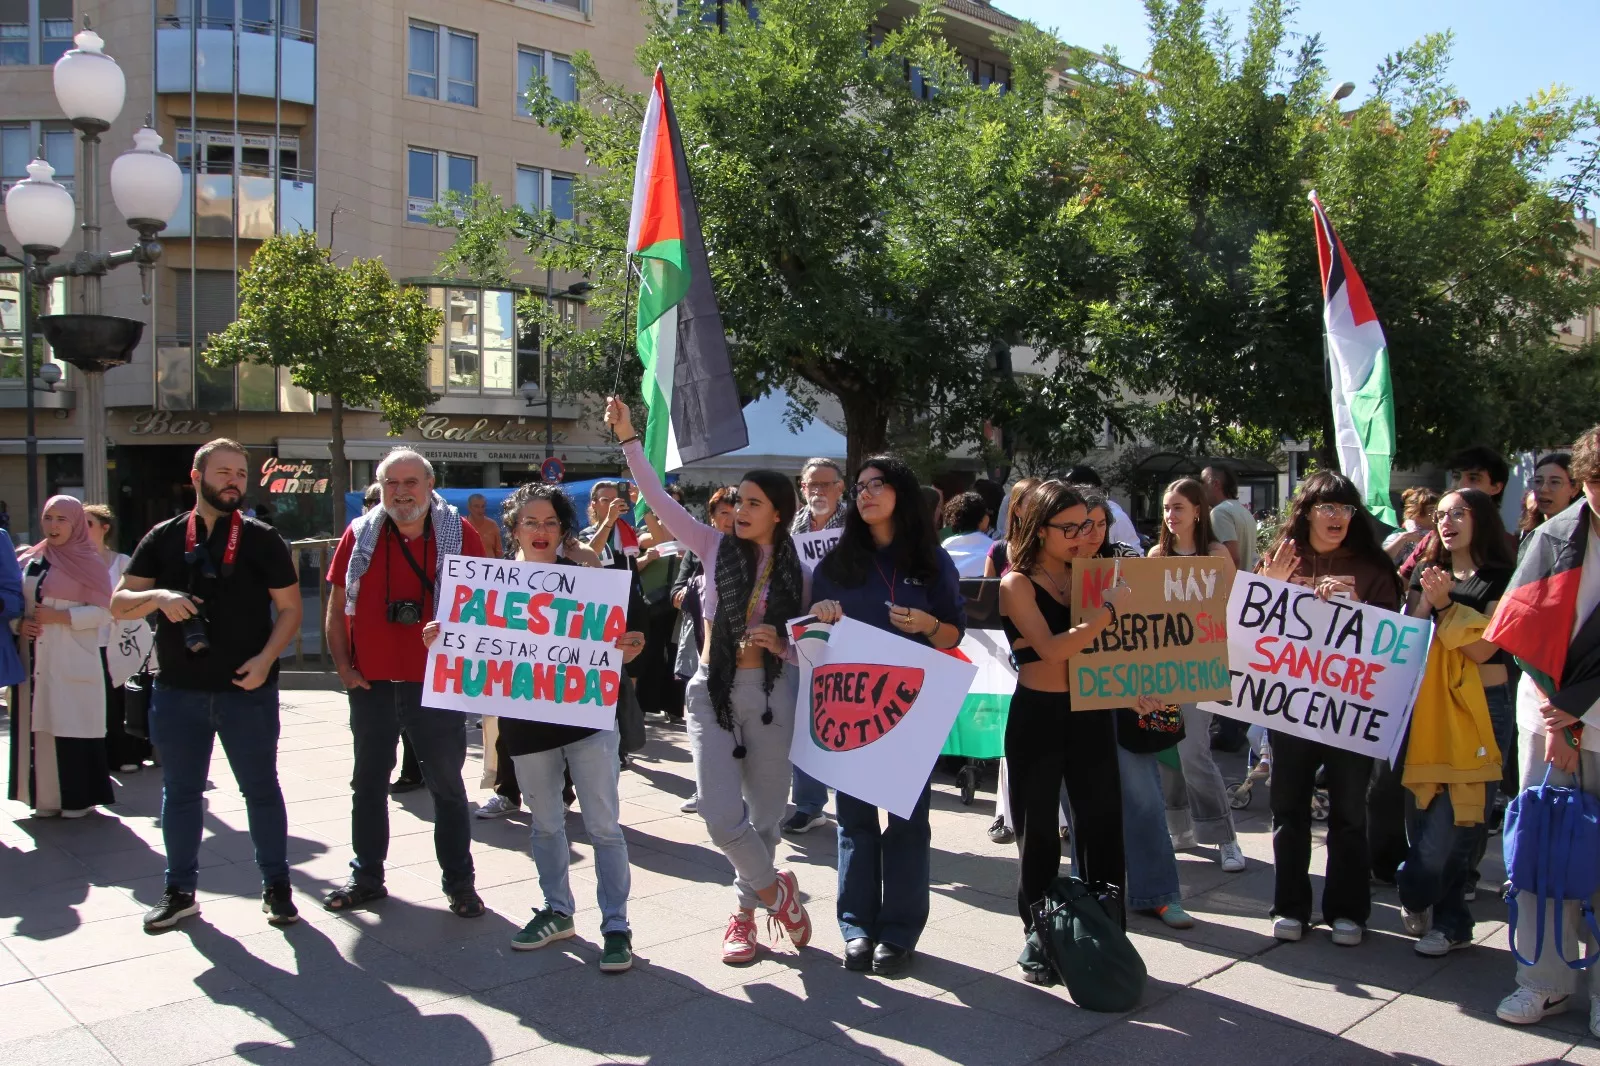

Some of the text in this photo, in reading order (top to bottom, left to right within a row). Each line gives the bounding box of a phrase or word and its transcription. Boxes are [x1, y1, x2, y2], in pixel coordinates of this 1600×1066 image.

[129, 410, 212, 435] Bar
[260, 457, 314, 487] Granja
[425, 451, 478, 460] RESTAURANTE
[518, 452, 540, 460] ANITA
[228, 525, 239, 550] Canon
[448, 560, 576, 594] ESTAR CON
[1164, 567, 1217, 602] HAY
[1238, 581, 1419, 664] BASTA DE
[443, 632, 610, 666] ES ESTAR CON LA
[1248, 635, 1386, 701] SANGRE
[824, 671, 870, 704] FREE
